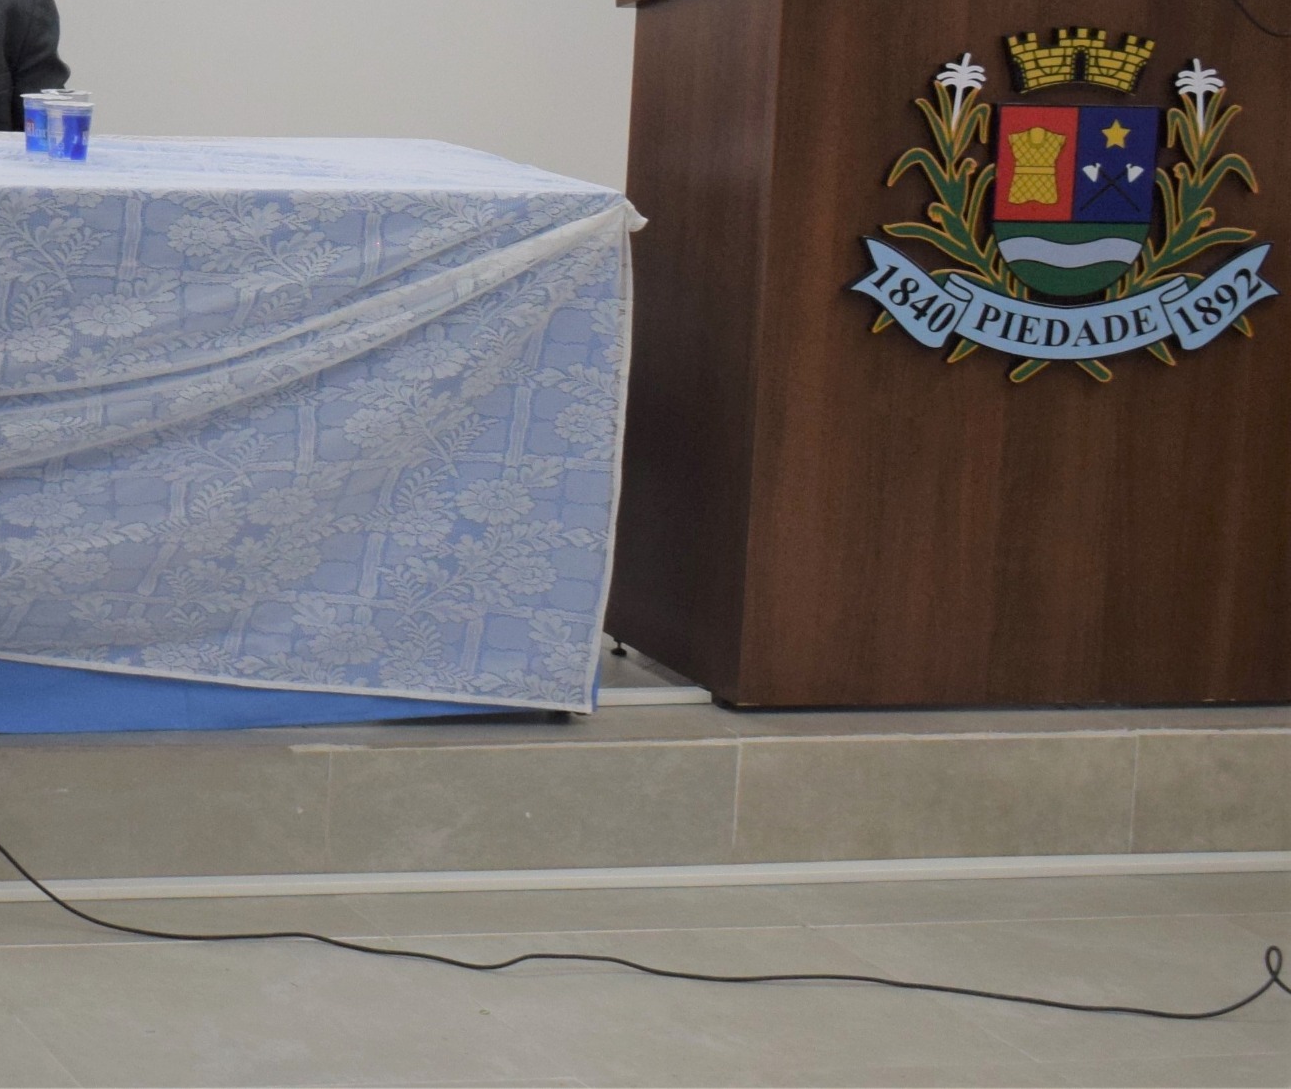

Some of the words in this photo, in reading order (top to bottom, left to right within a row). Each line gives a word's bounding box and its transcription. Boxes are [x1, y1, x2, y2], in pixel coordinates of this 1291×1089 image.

[871, 264, 956, 334] 1840
[972, 302, 1158, 348] PIEDADE
[1173, 267, 1263, 336] 1892
